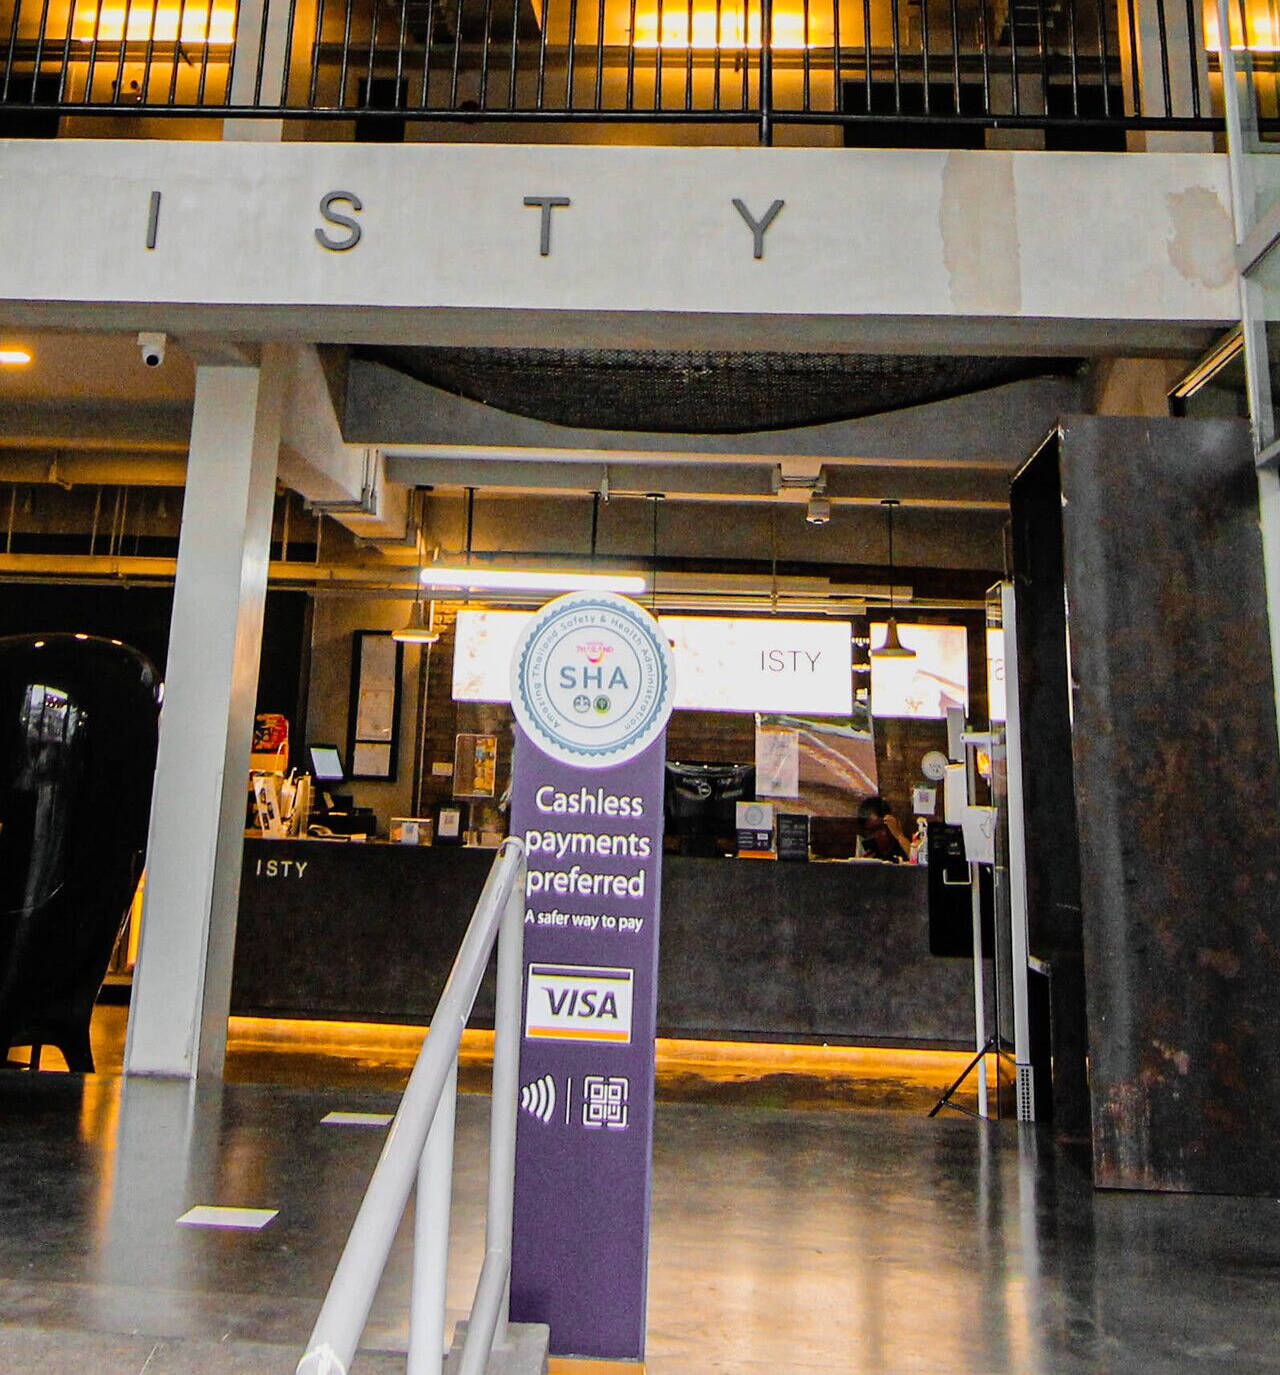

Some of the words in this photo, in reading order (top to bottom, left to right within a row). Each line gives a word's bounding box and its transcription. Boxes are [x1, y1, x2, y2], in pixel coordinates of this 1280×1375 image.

[145, 190, 785, 260] ISTY
[561, 614, 596, 630] Safety
[611, 618, 642, 646] Health
[532, 630, 559, 677] Thailand
[759, 650, 822, 673] ISTY
[559, 666, 629, 689] SHA
[624, 647, 654, 730] Administration
[534, 682, 561, 729] Amazing
[535, 785, 644, 817] Cashless
[525, 829, 652, 858] payments
[256, 858, 309, 879] ISTY
[525, 865, 646, 898] preferred
[524, 908, 536, 924] A
[537, 909, 570, 926] safer
[571, 913, 599, 931] way
[601, 914, 616, 928] to
[618, 916, 644, 934] pay
[541, 987, 619, 1020] VISA
